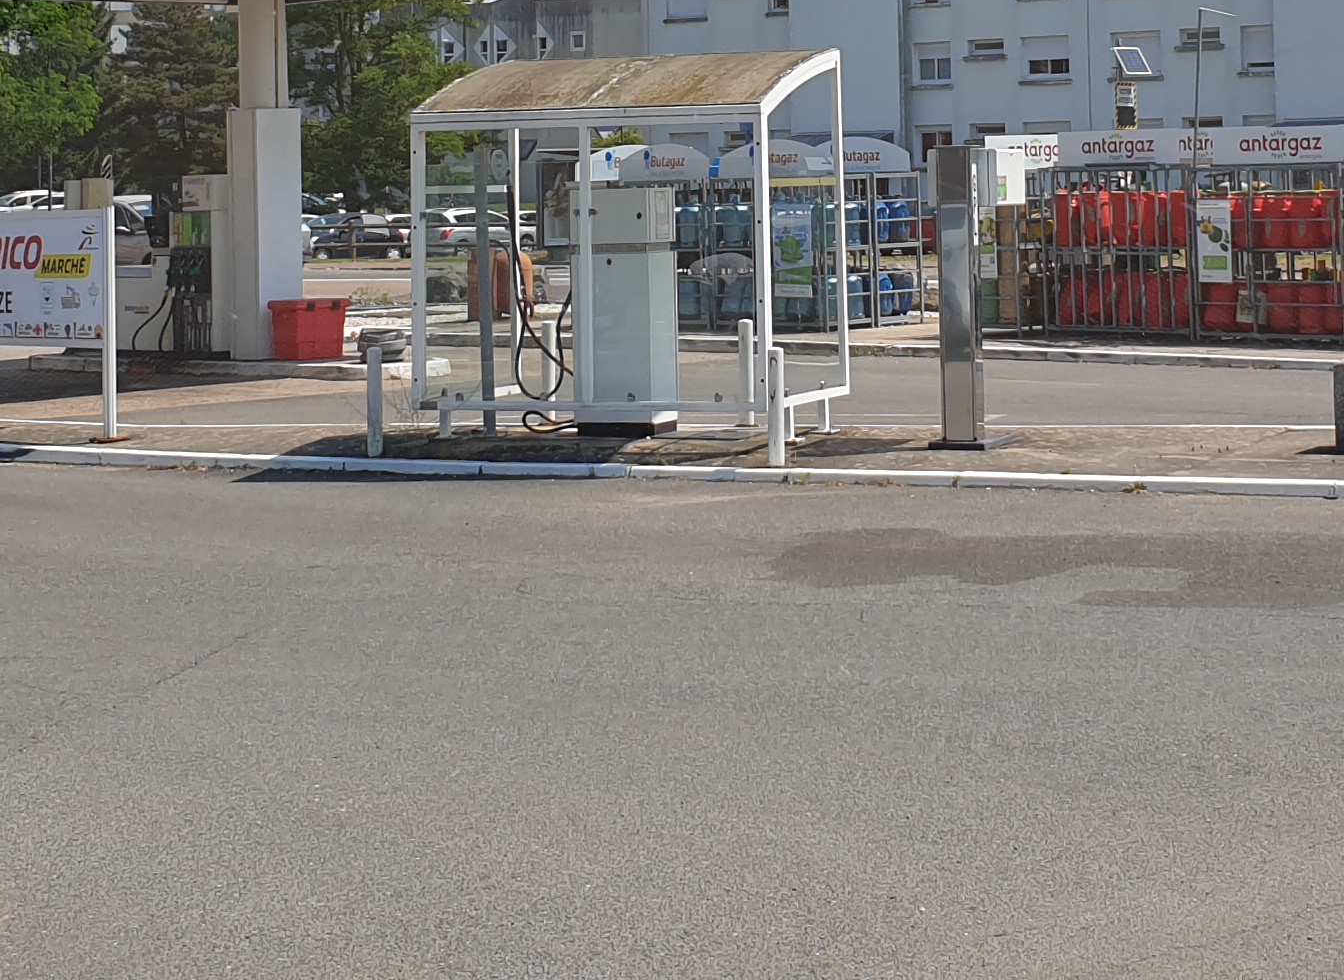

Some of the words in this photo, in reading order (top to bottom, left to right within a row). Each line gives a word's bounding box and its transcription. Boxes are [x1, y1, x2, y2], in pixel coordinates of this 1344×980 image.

[1082, 138, 1155, 159] antargaz
[1239, 135, 1322, 157] antargaz
[650, 155, 686, 169] Butagaz
